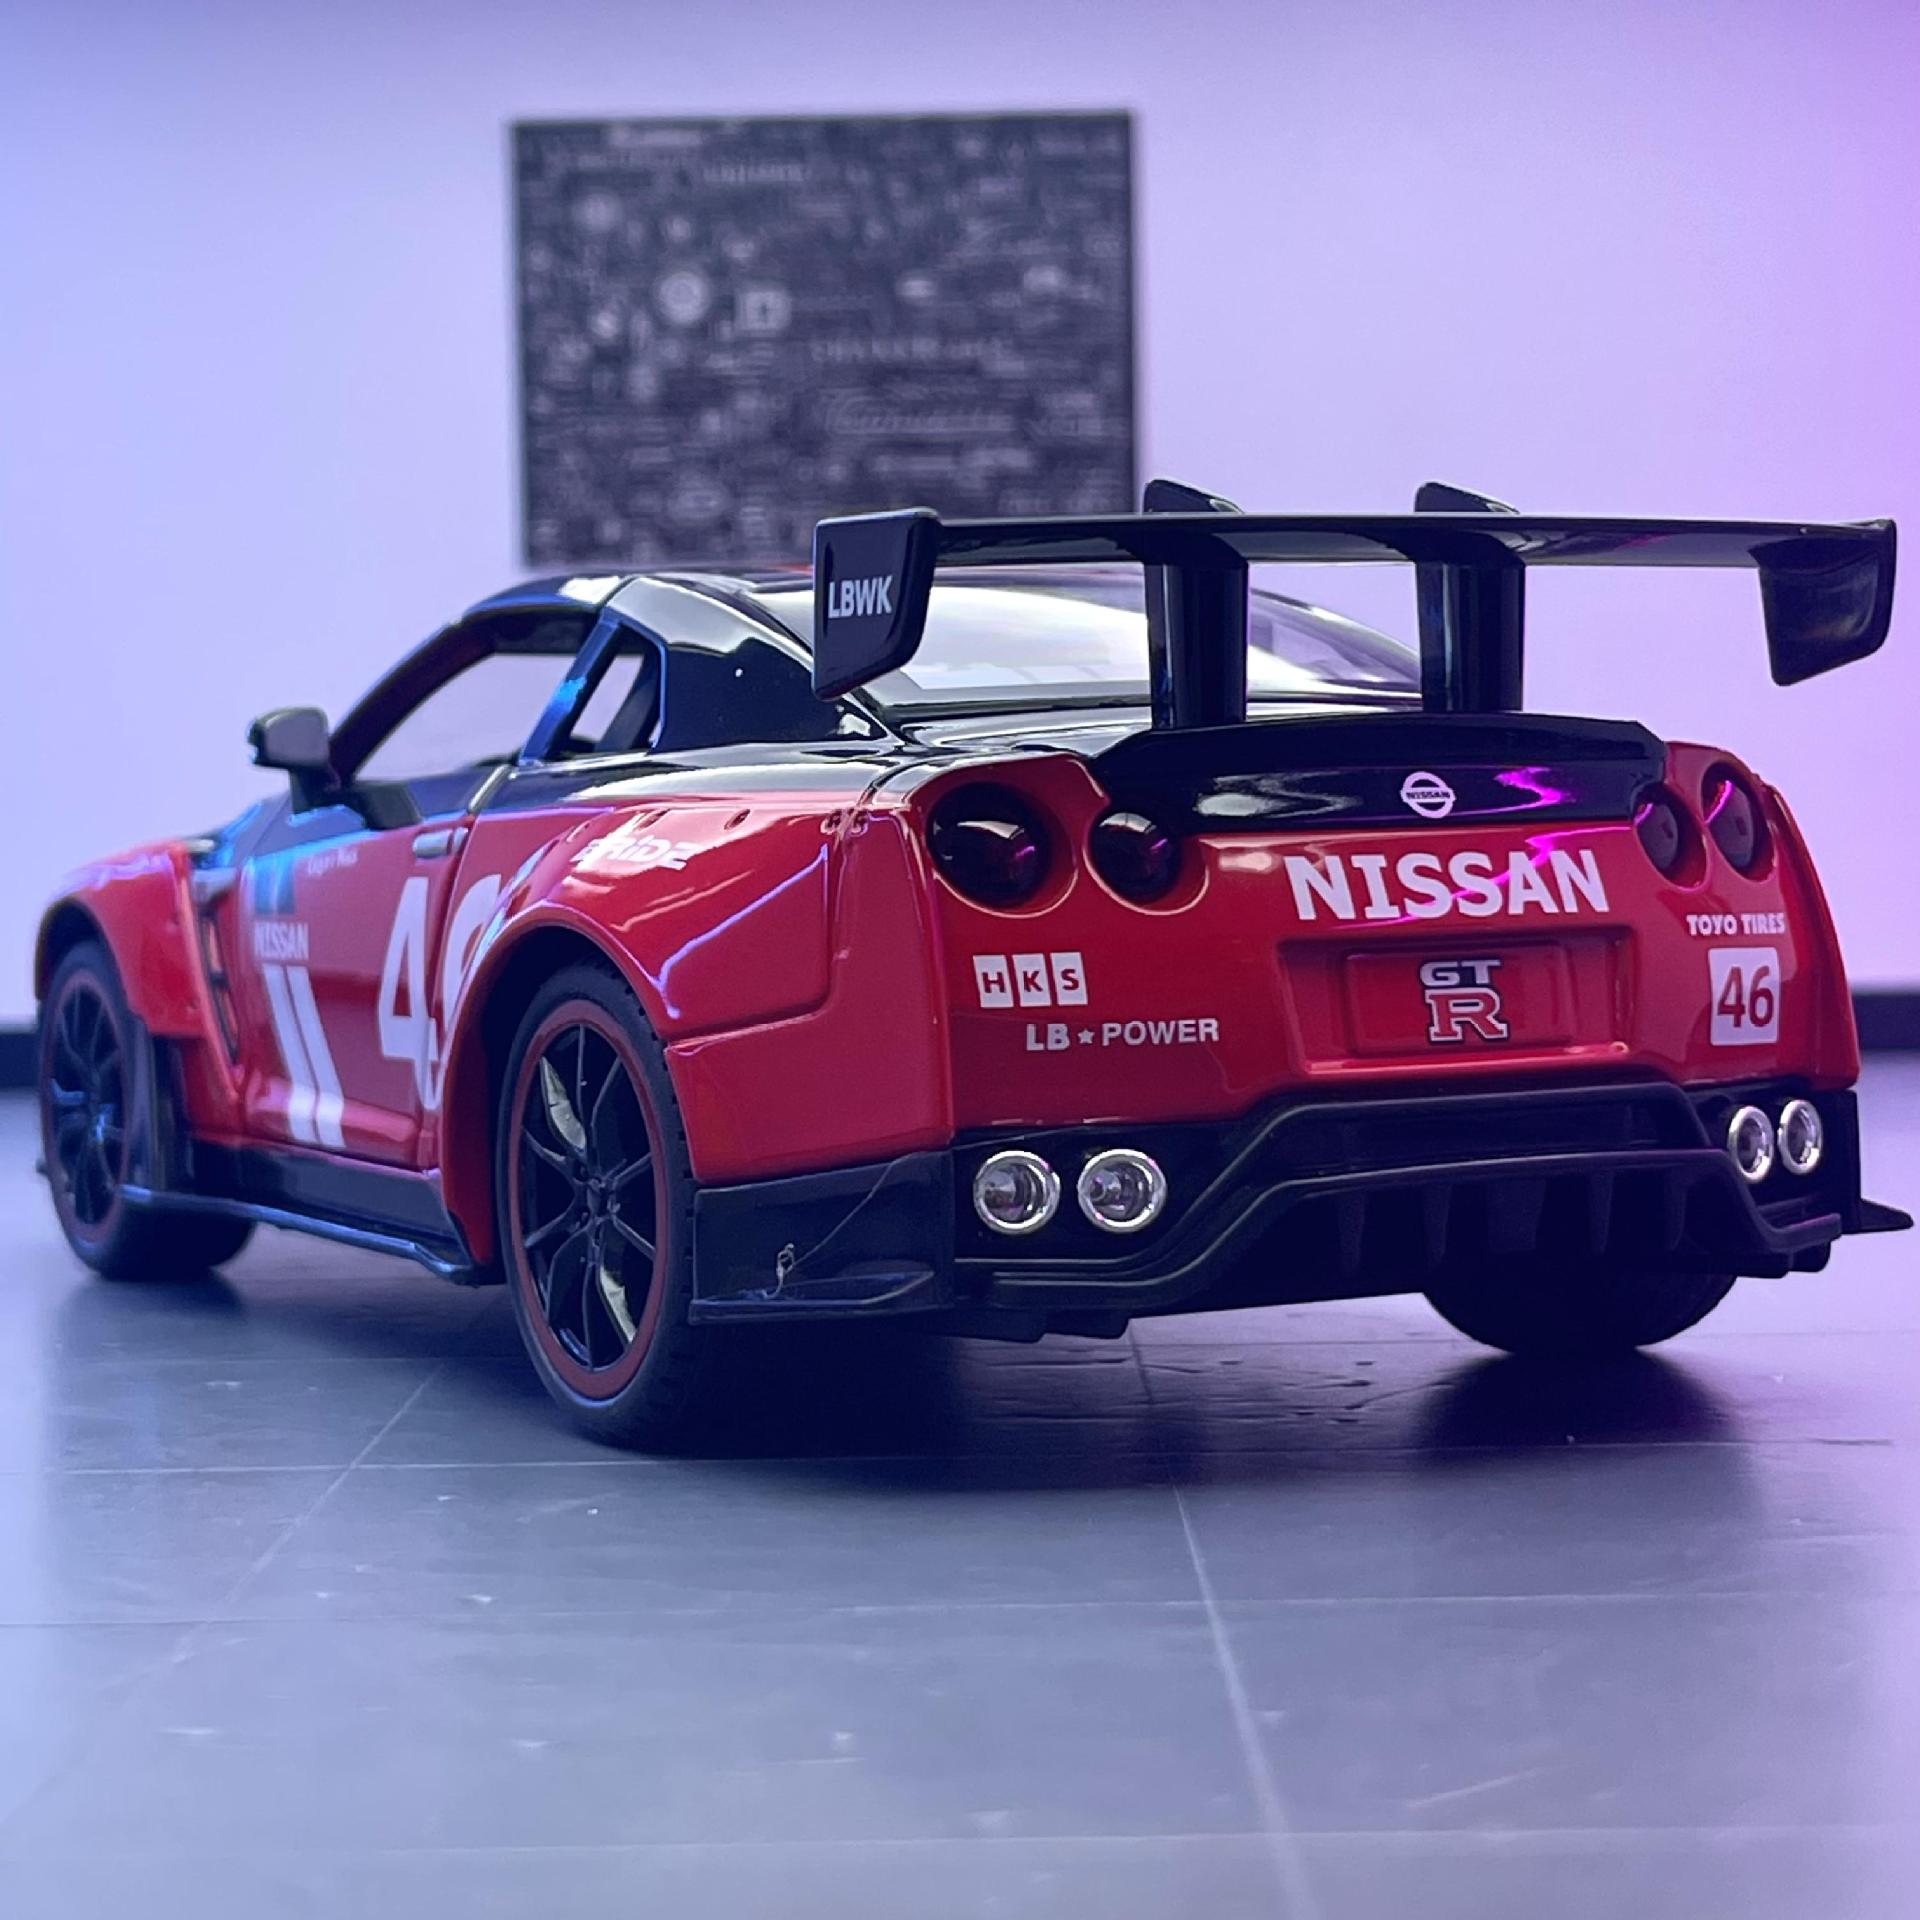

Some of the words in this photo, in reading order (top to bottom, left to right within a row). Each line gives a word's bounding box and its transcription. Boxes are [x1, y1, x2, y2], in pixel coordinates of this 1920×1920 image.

[828, 575, 893, 619] LBWK
[1283, 849, 1609, 921] NISSAN
[254, 922, 309, 960] NISSAN
[1686, 914, 1738, 936] TOYO
[1740, 912, 1785, 935] TIRES
[1420, 959, 1503, 987] GT
[1425, 987, 1508, 1042] R
[1717, 966, 1774, 1028] 46
[1026, 1023, 1070, 1051] LB
[1102, 1018, 1219, 1046] POWER
